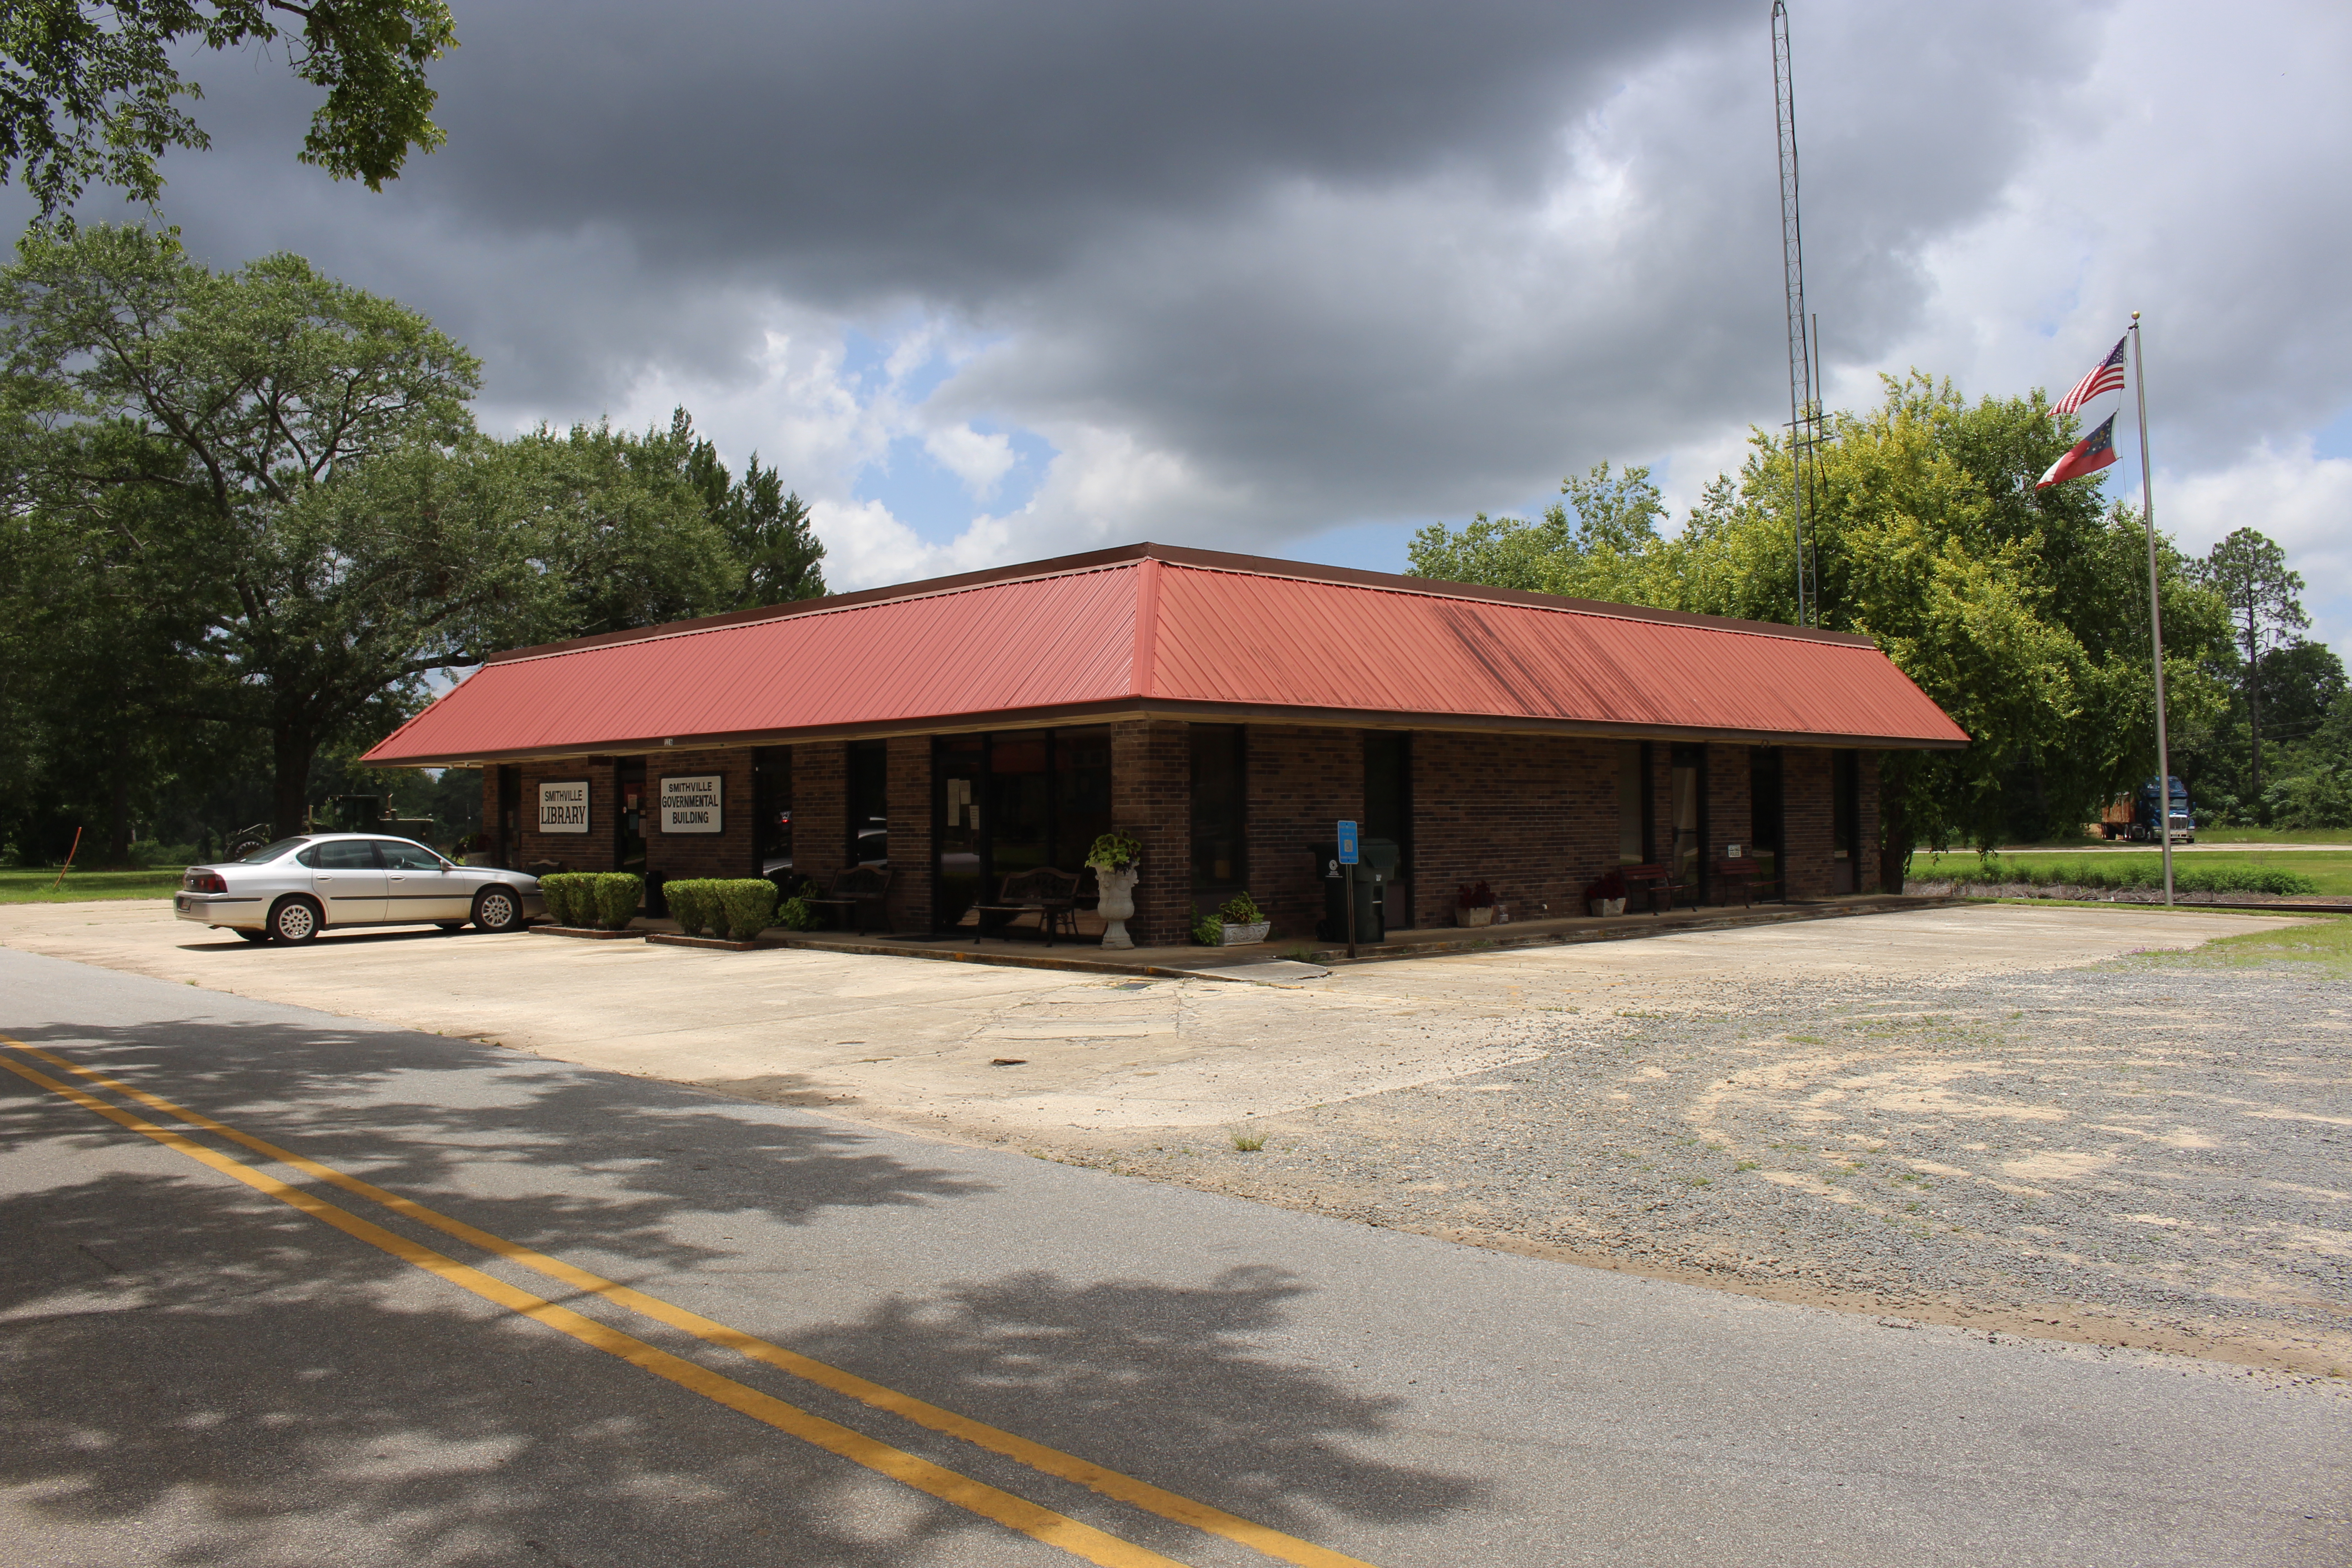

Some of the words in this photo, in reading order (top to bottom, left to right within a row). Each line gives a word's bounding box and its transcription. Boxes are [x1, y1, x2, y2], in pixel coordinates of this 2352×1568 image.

[669, 782, 712, 792] SMITHVILLE
[545, 790, 582, 802] SMITHVILLE
[662, 794, 718, 808] GOVERNMENTAL
[541, 806, 586, 824] LIBRARY
[673, 811, 708, 824] BUILDING
